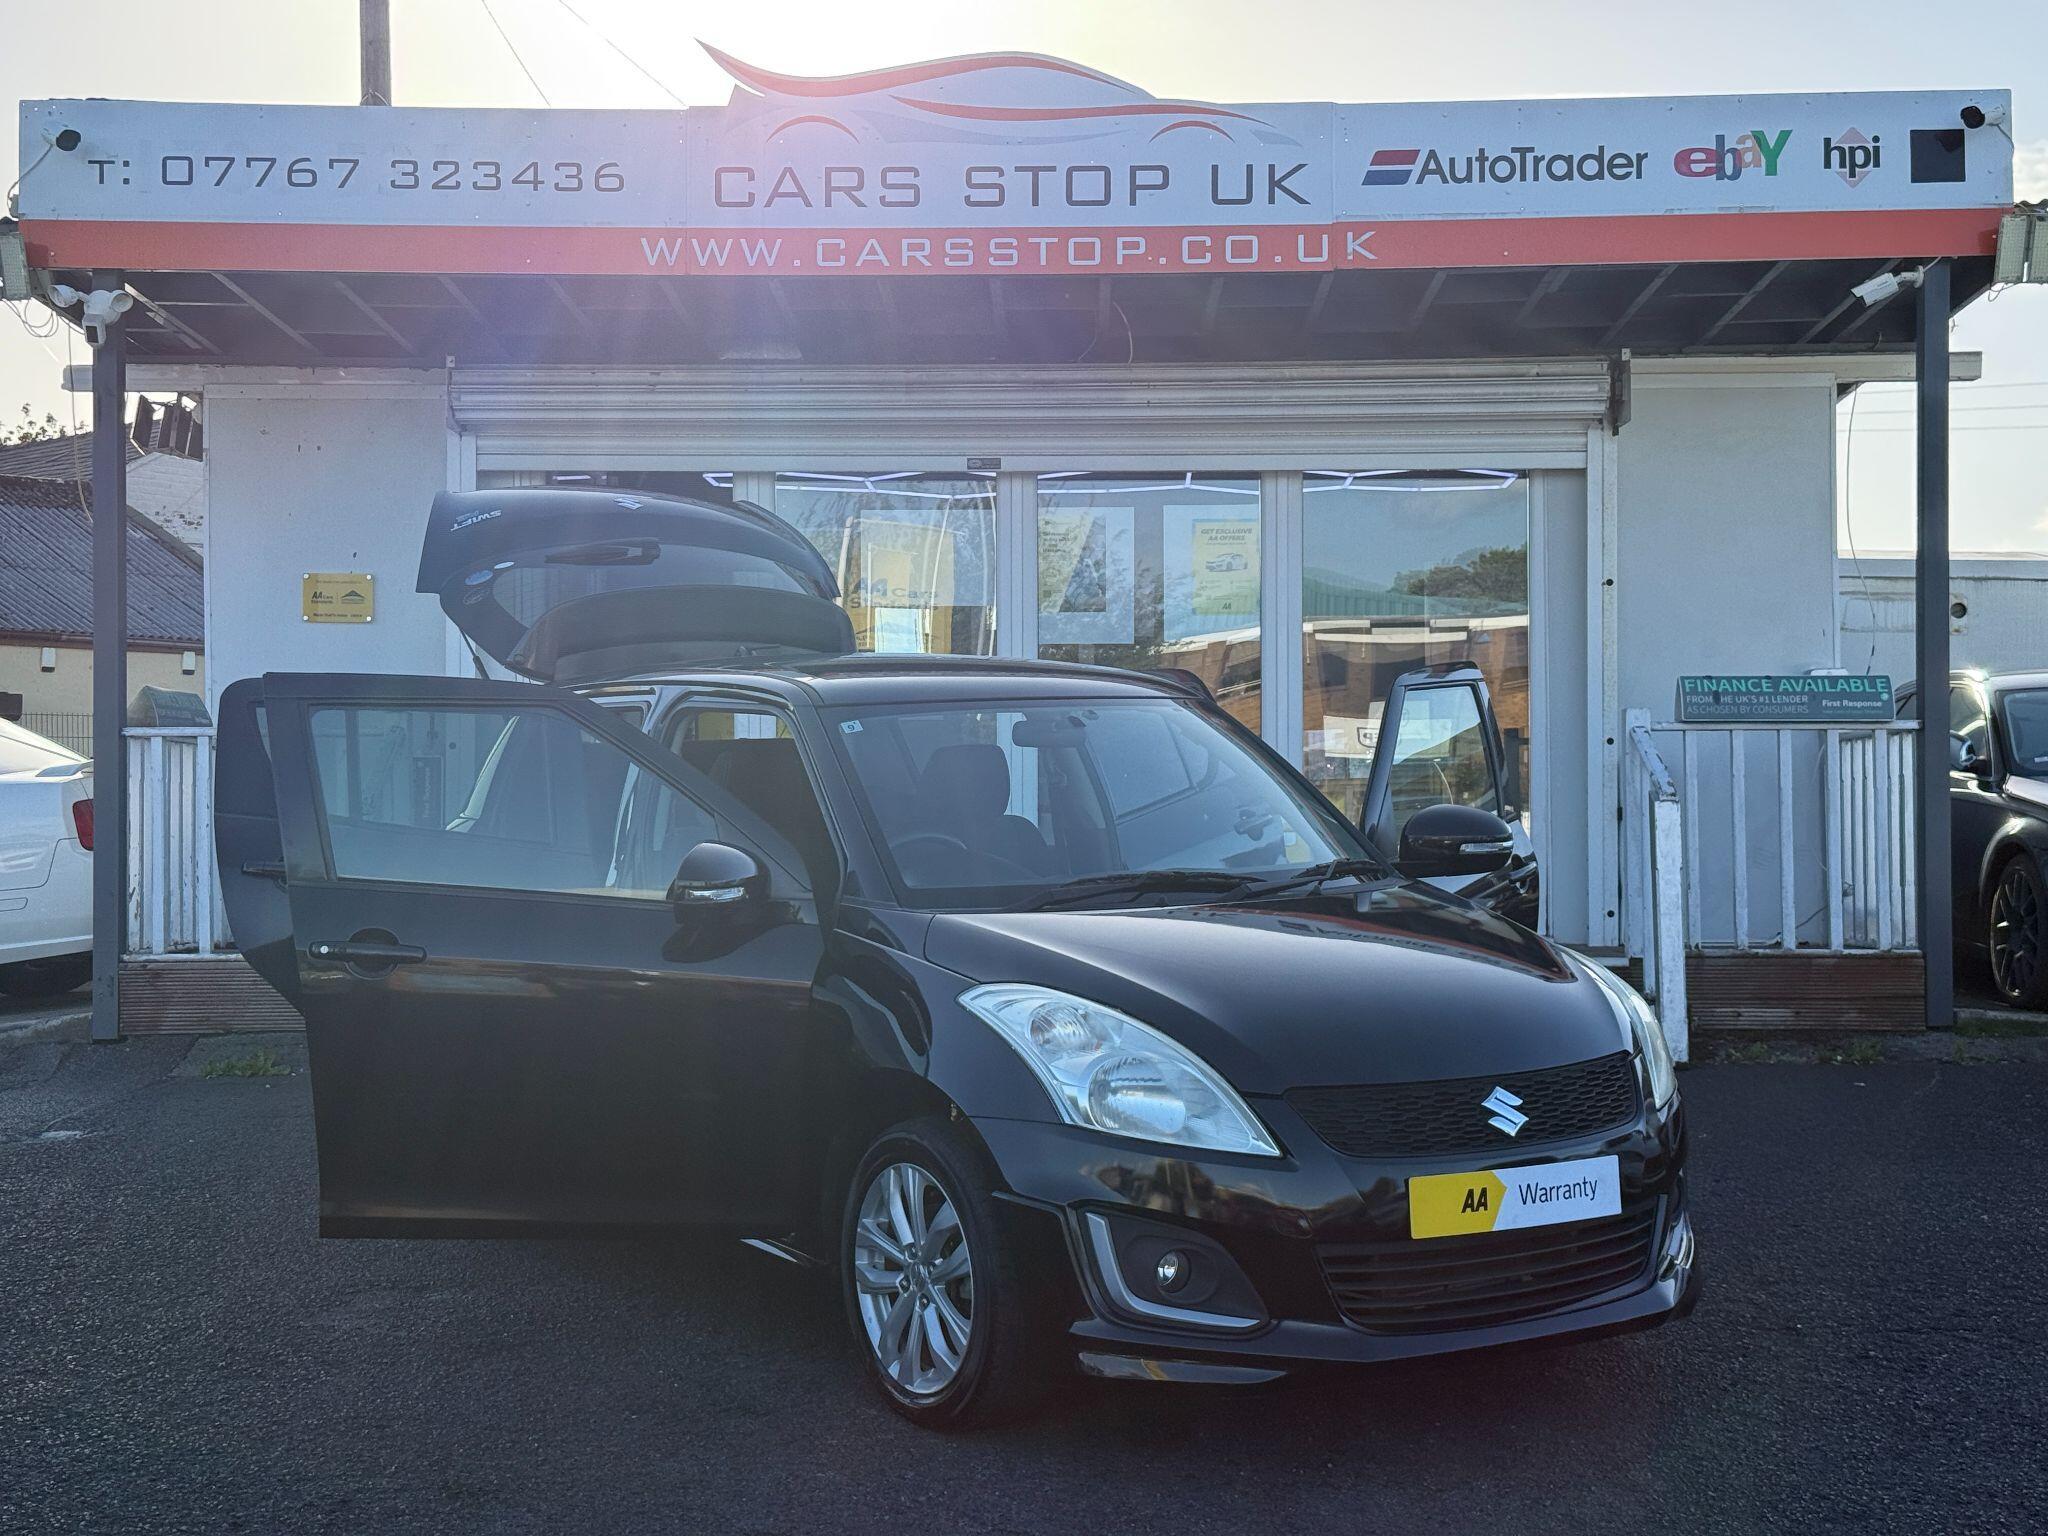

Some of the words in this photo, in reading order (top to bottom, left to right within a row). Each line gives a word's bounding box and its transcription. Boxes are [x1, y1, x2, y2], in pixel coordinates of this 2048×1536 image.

[1415, 145, 1648, 185] AutoTrader
[1823, 134, 1881, 178] hpi
[87, 159, 131, 186] T:
[161, 156, 361, 188] 07767
[390, 160, 626, 193] 323436
[714, 165, 922, 209] CARS
[964, 164, 1171, 208] STOP
[1210, 163, 1312, 206] UK
[640, 231, 1377, 267] WWW.CARSSTOP.CO.UK
[450, 509, 502, 532] SWIFT
[1684, 678, 1773, 692] FINANCE
[1779, 678, 1889, 692] AVAILABLE
[1686, 695, 1713, 703] FROM
[1715, 695, 1733, 703] HE
[1735, 695, 1758, 703] UK'S
[1771, 694, 1808, 703] LENDER
[1699, 705, 1738, 714] CHOSEN
[1740, 705, 1751, 714] BY
[1752, 705, 1809, 714] CONSUMERS
[1822, 699, 1841, 707] First
[1842, 699, 1883, 708] Response
[1460, 1186, 1489, 1215] AA
[1518, 1176, 1596, 1205] Warranty
